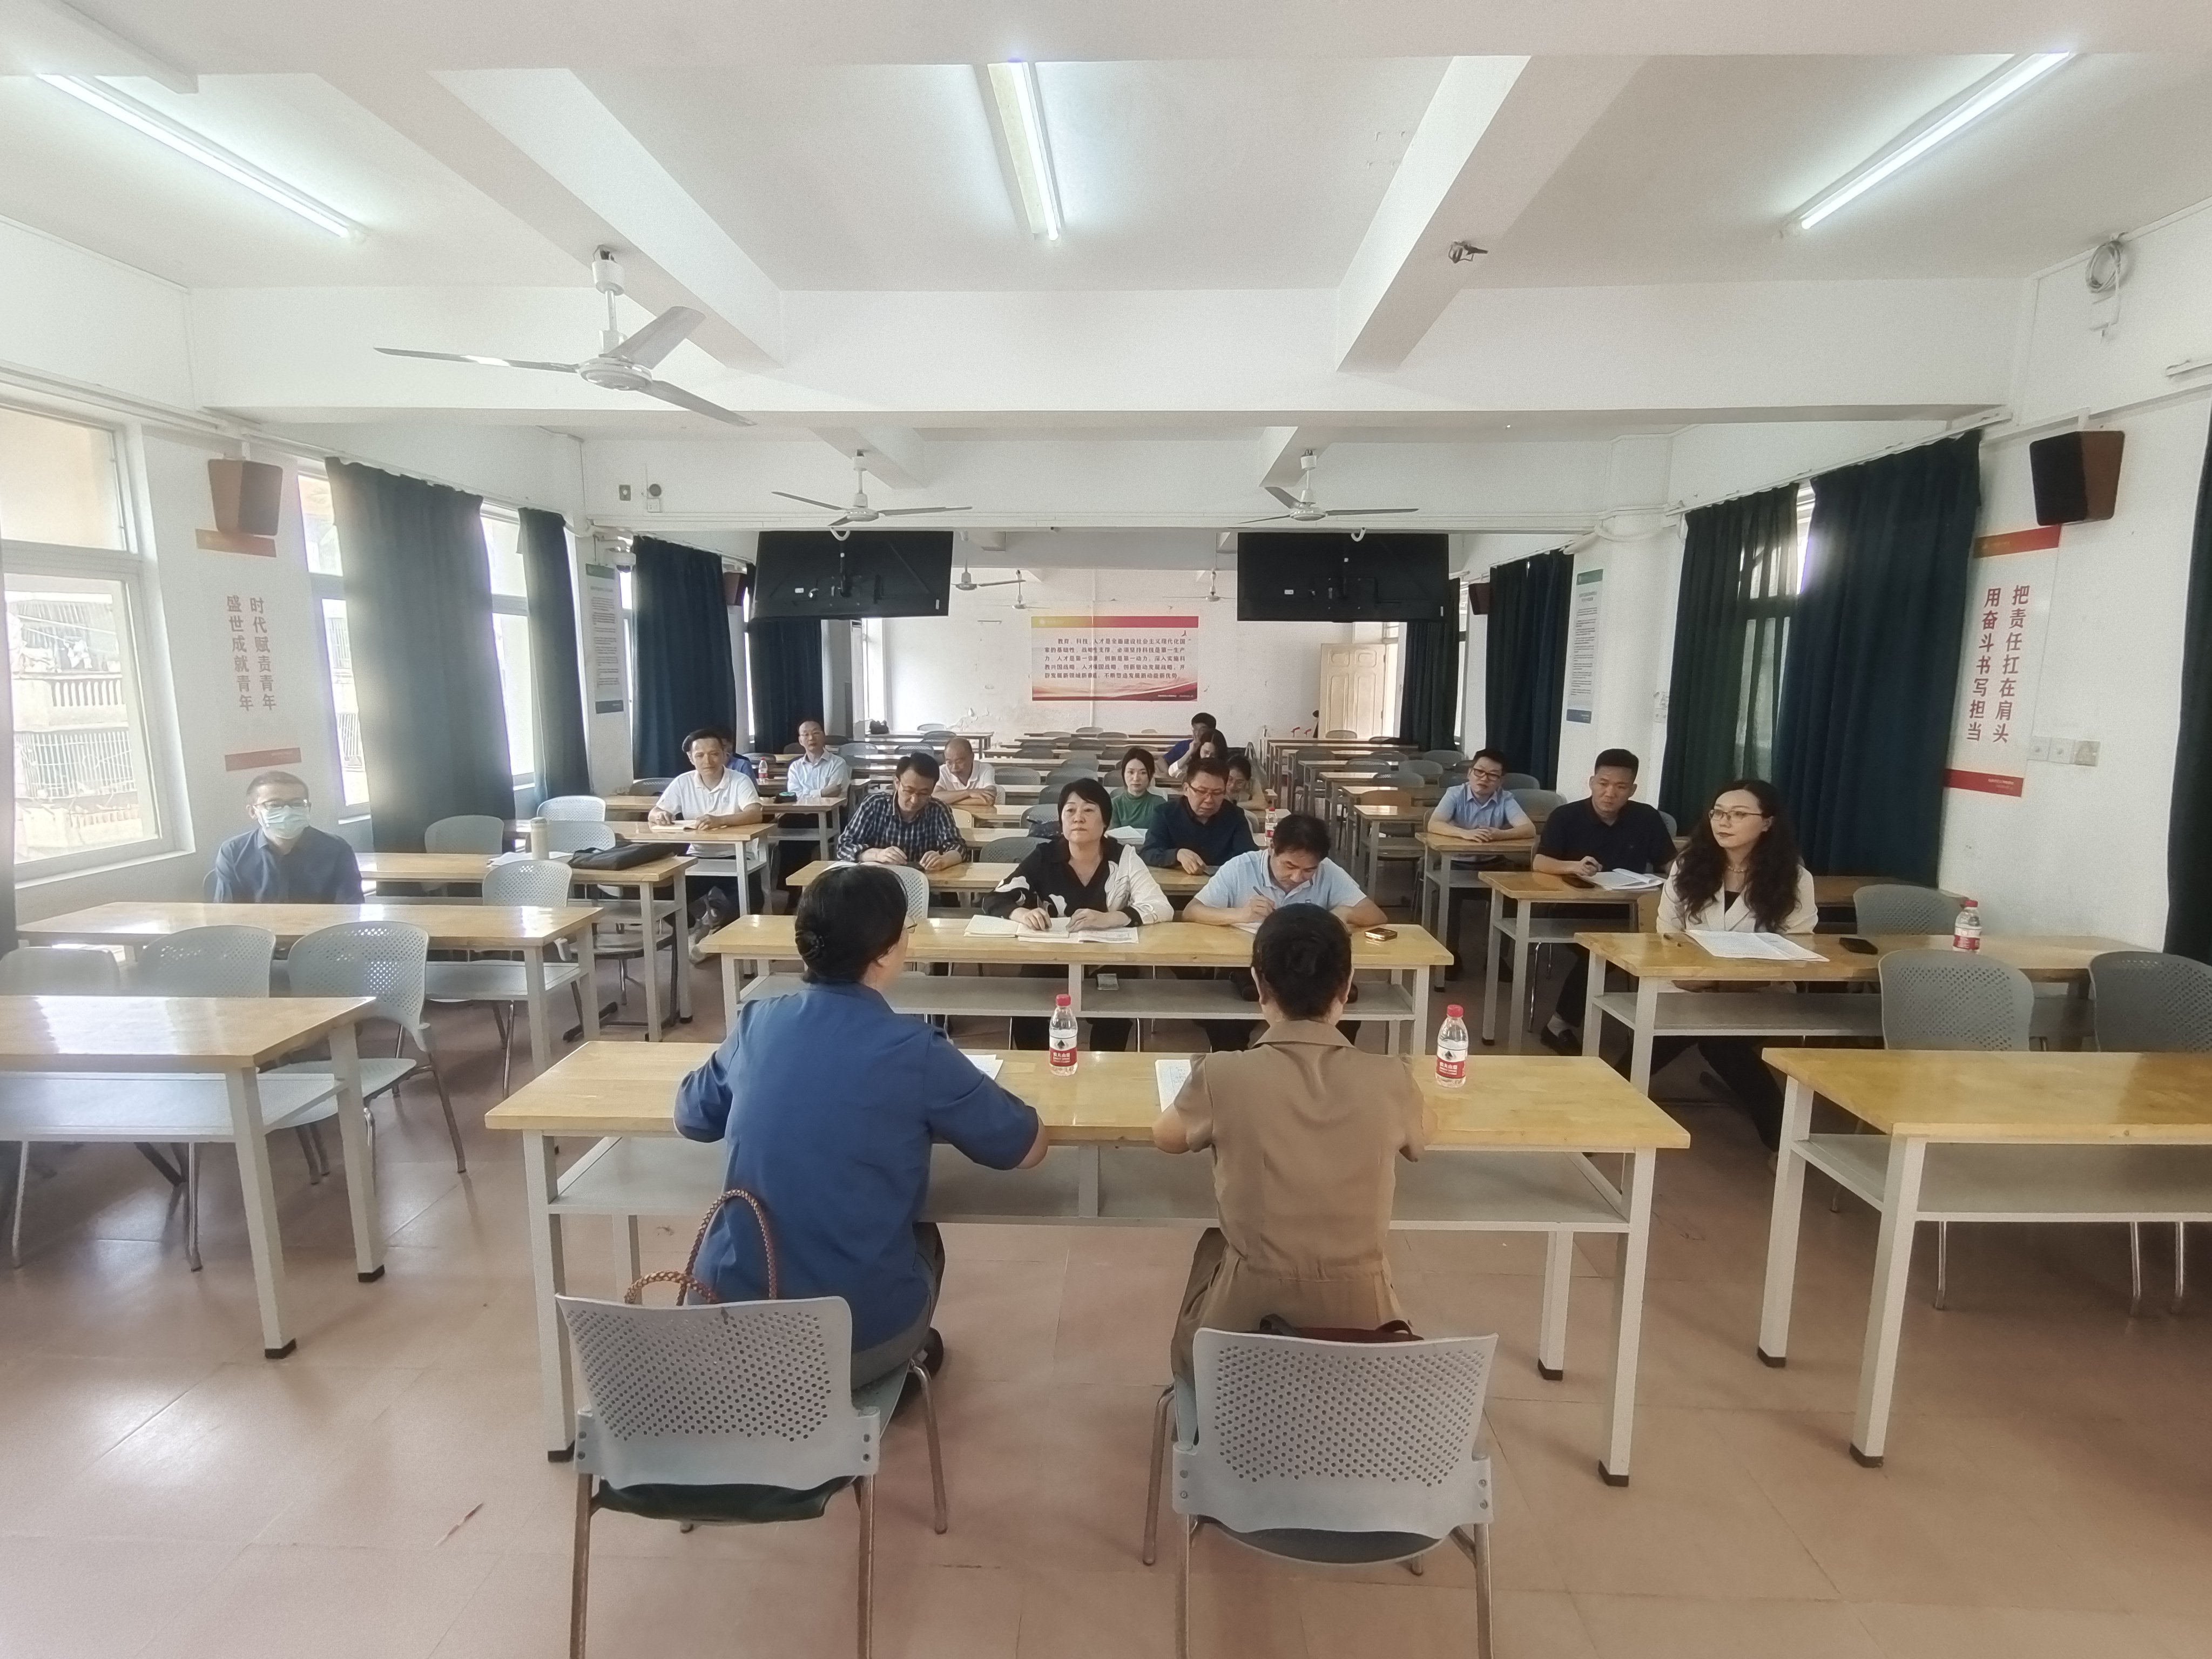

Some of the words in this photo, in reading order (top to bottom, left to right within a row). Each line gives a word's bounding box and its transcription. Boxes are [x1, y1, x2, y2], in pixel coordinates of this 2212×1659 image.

[227, 595, 254, 711] 盛世成就青年
[250, 597, 276, 711] 时代赋责青年
[1966, 588, 2001, 741] 用奋斗书写担当
[1993, 585, 2030, 744] 把责任扛在肩头
